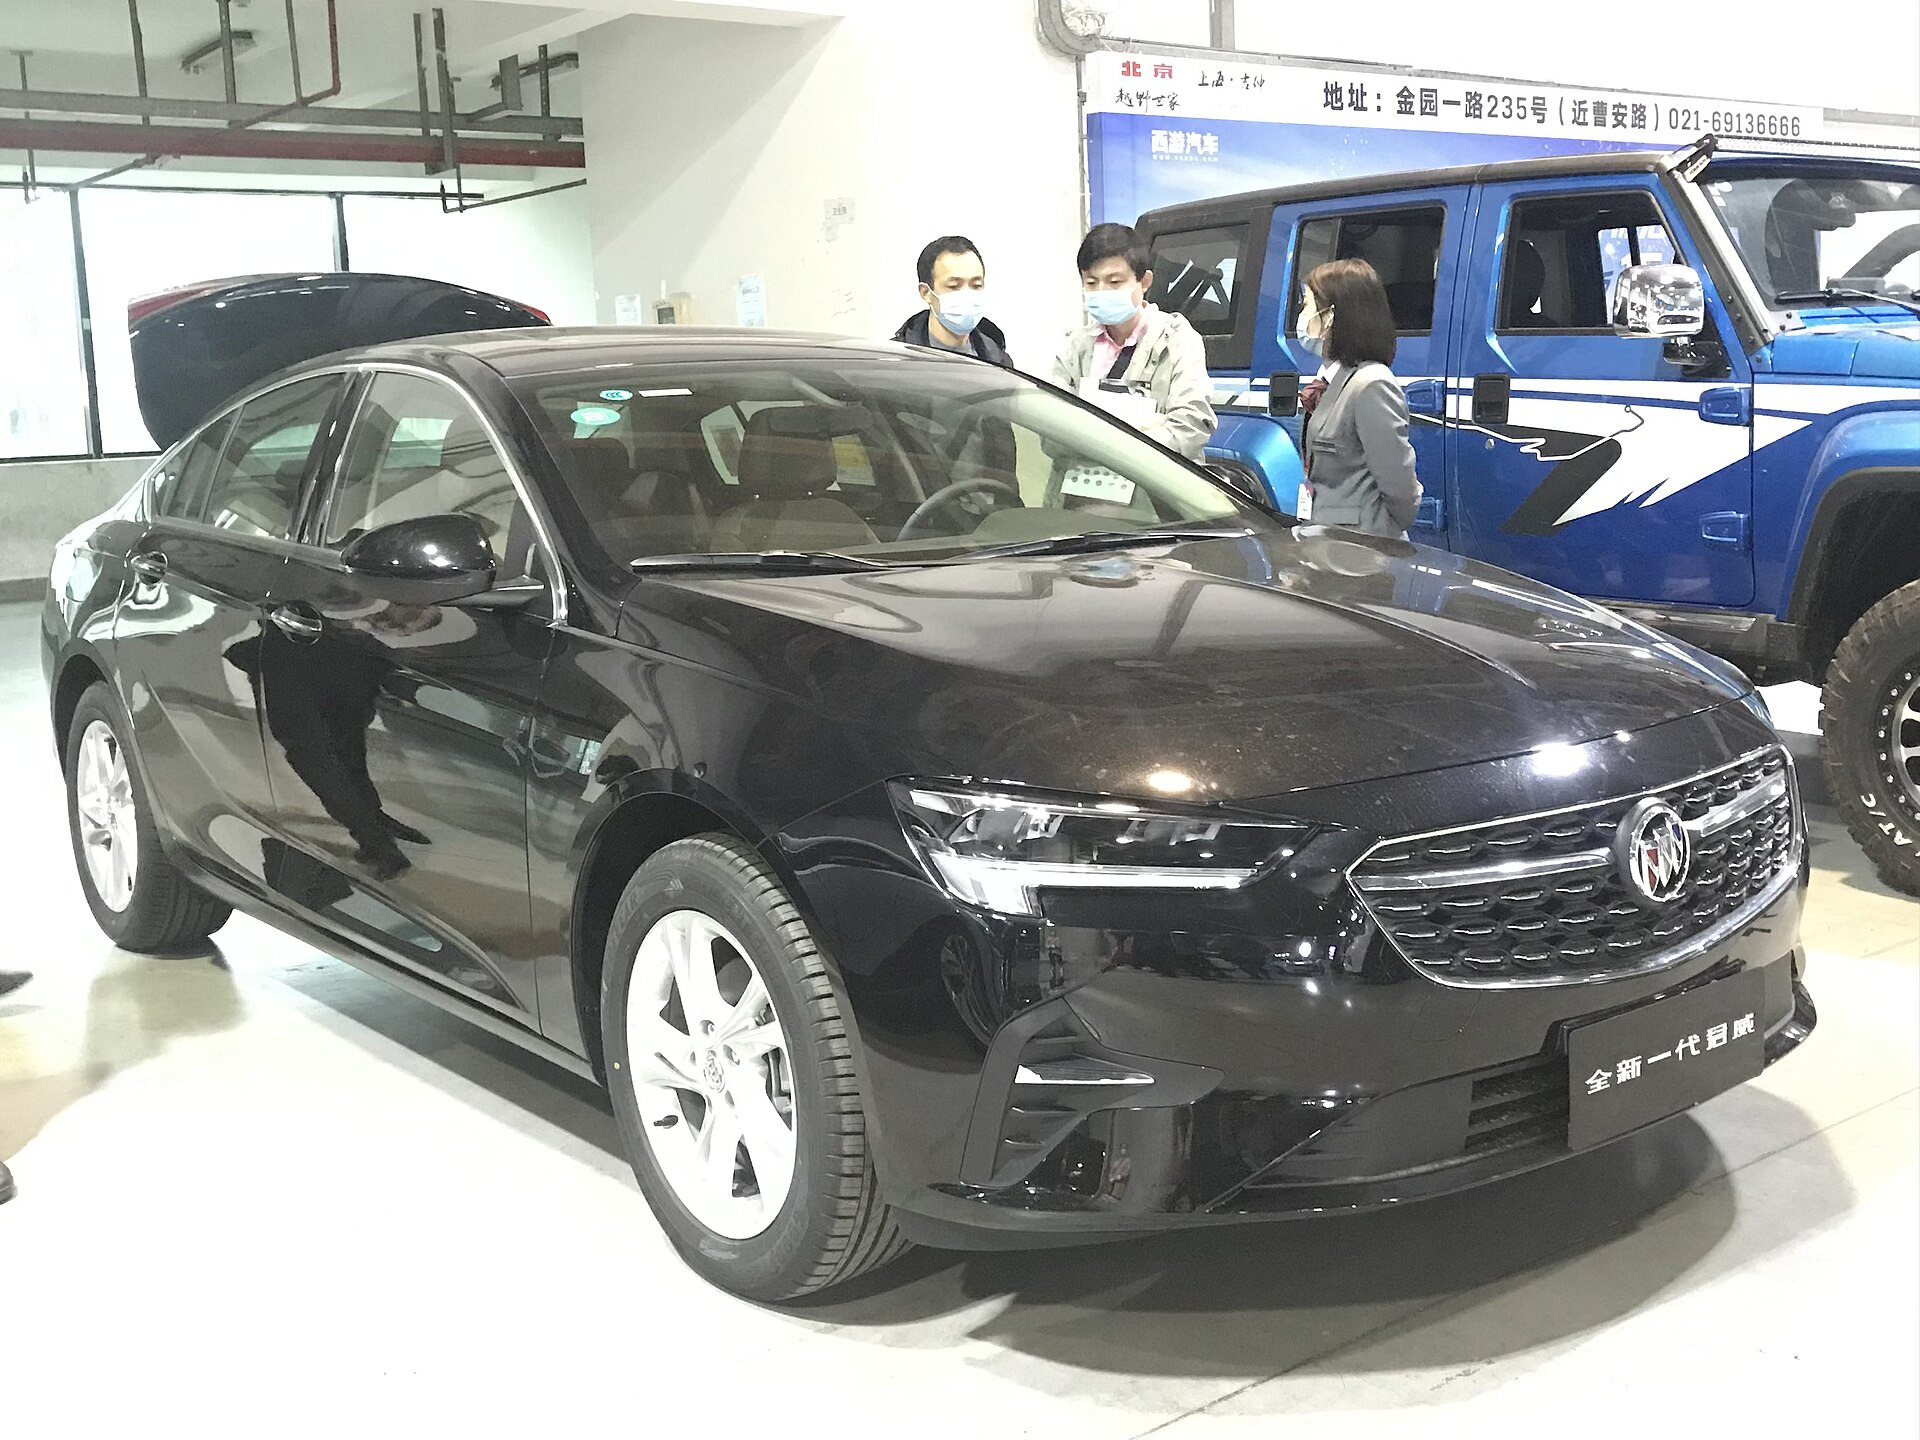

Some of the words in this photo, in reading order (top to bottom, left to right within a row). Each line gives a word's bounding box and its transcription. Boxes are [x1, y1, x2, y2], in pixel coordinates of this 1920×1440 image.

[1121, 60, 1173, 79] 北京
[1585, 1013, 1756, 1095] 全新一代君威
